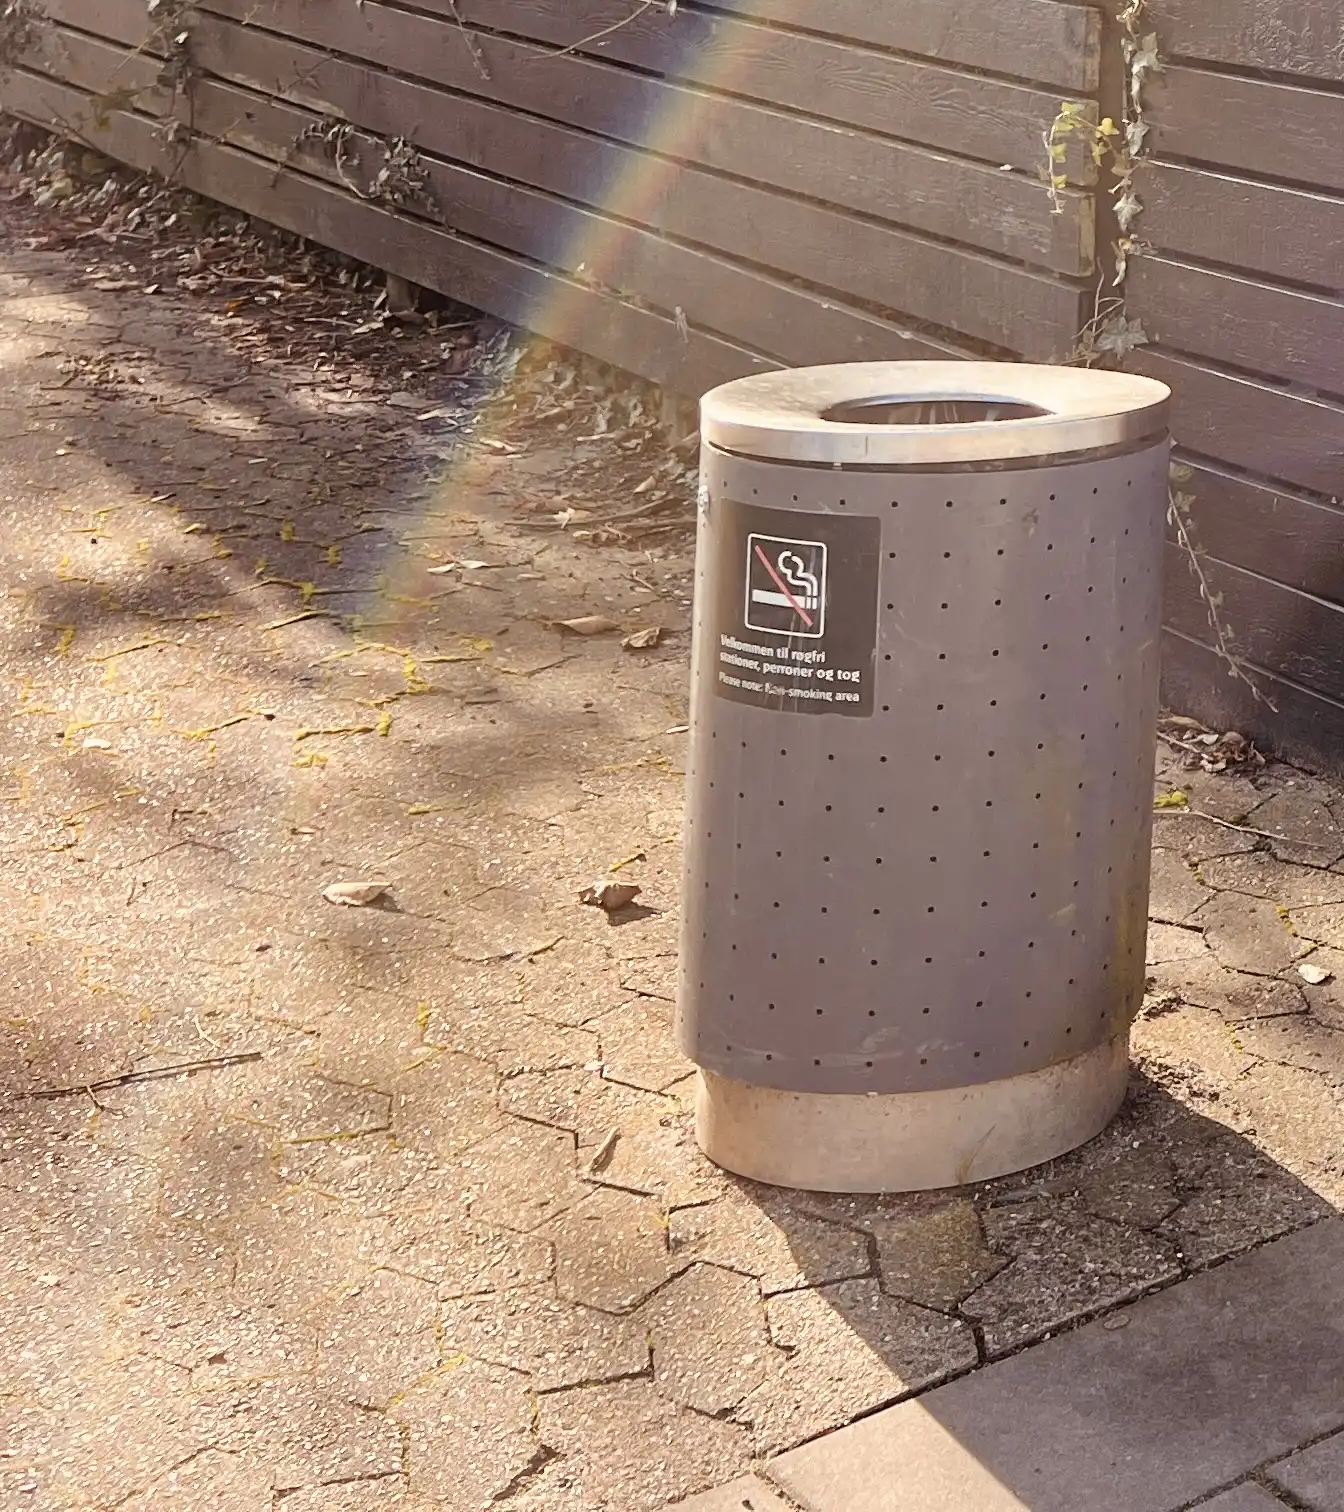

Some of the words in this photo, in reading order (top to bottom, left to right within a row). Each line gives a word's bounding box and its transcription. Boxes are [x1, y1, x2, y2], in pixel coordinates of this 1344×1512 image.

[720, 633, 774, 657] Velkommen
[776, 647, 789, 659] til
[720, 651, 760, 672] stationer,
[763, 662, 814, 678] perroner
[816, 669, 834, 681] og
[837, 669, 860, 683] tog
[718, 671, 741, 688] Please
[835, 691, 860, 702] area
